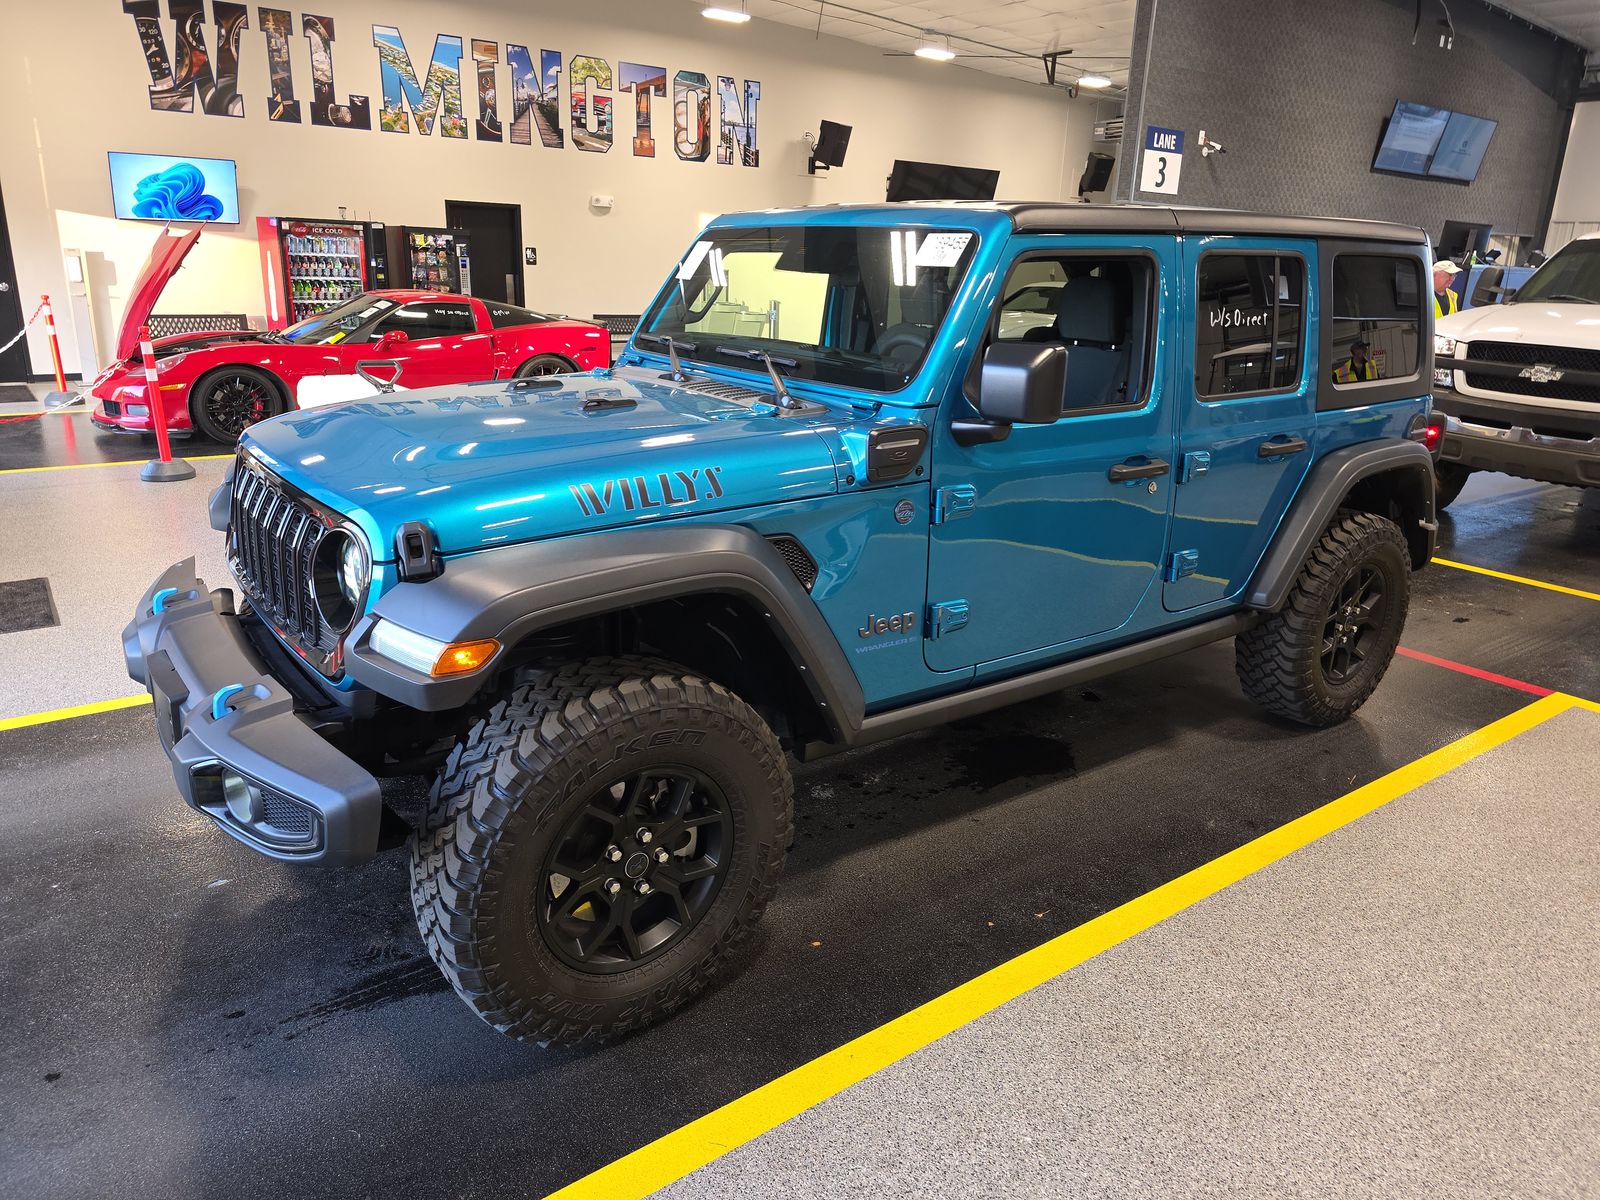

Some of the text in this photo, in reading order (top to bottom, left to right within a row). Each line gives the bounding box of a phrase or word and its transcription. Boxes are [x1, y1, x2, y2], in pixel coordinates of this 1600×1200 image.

[122, 0, 761, 168] WILMINGTON
[1153, 132, 1177, 151] LANE
[1155, 156, 1167, 188] 3
[1234, 308, 1268, 327] Direct
[569, 466, 722, 516] WILLYS
[858, 611, 917, 639] Jeep
[855, 639, 909, 654] WRANGLER
[532, 728, 709, 837] FALKEN
